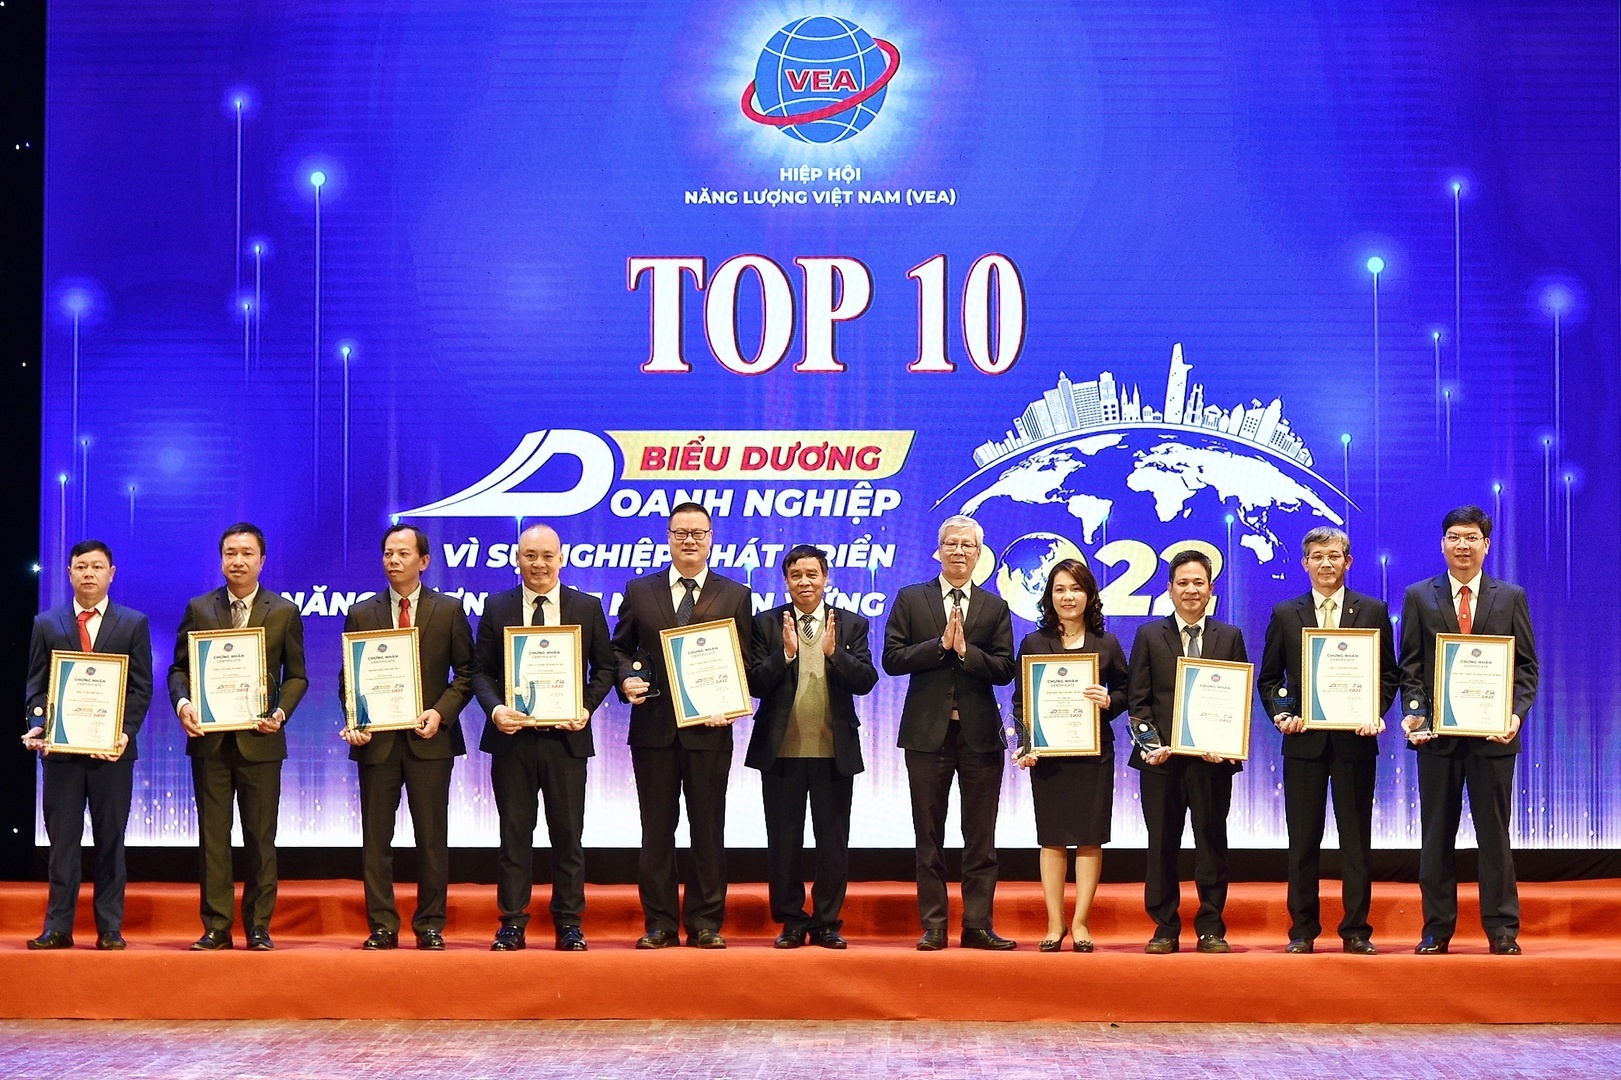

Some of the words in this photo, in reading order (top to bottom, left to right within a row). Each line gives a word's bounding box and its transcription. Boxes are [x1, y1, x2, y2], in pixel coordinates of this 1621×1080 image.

[784, 68, 858, 93] VEA
[779, 165, 823, 184] HIỆP
[827, 165, 862, 184] HỘI
[684, 187, 739, 205] NĂNG
[743, 188, 809, 208] LƯỢNG
[812, 187, 853, 208] VIỆT
[858, 190, 901, 205] NAM
[906, 188, 957, 206] (VEA)
[626, 253, 873, 376] TOP
[906, 253, 1027, 376] 10
[640, 435, 730, 471] BIỂU
[740, 441, 882, 471] DƯƠNG
[743, 481, 901, 525] NGHIỆP
[443, 536, 479, 568] VÌ
[705, 537, 785, 568] HÁT
